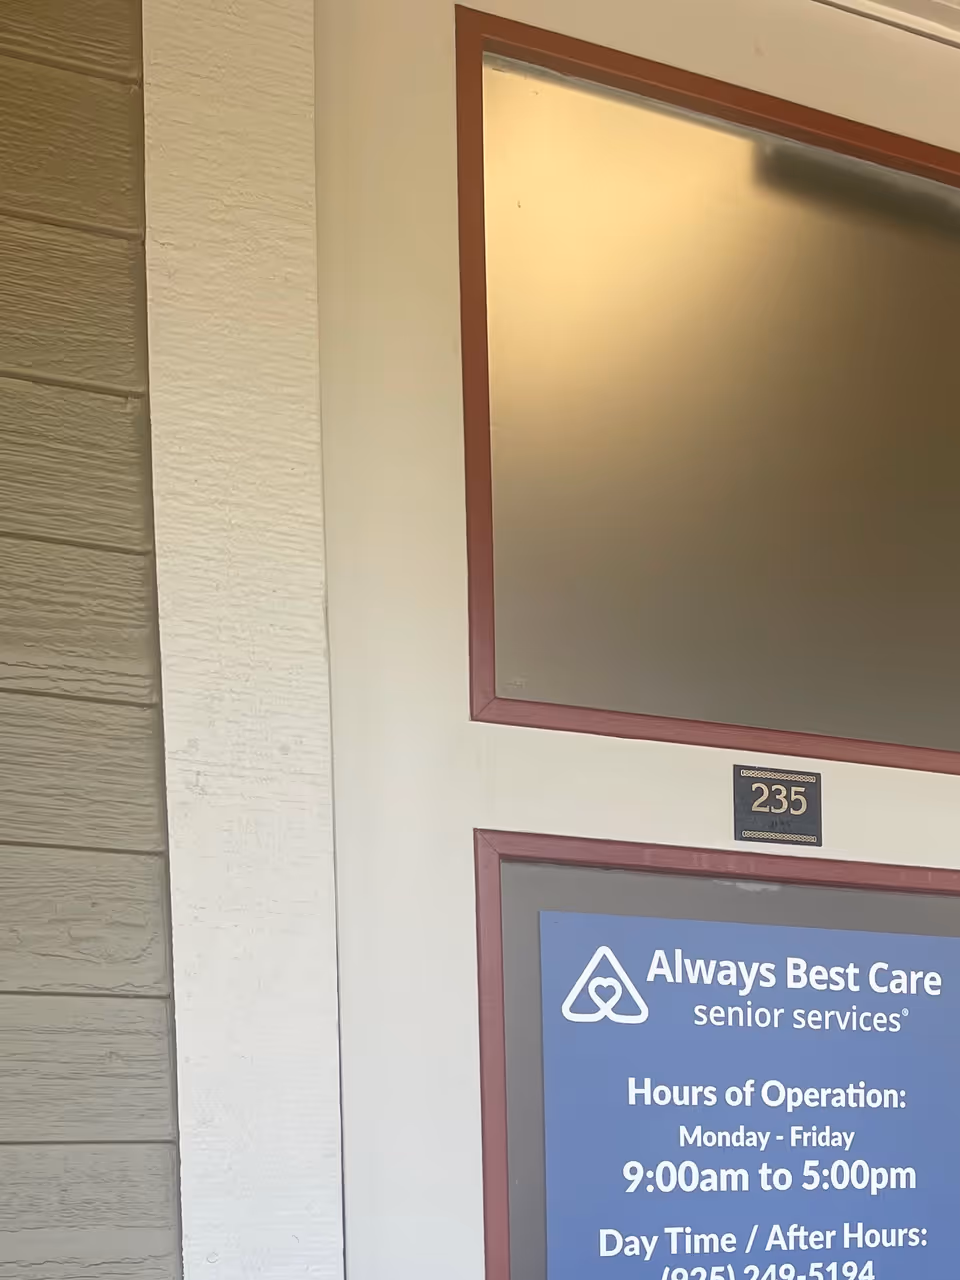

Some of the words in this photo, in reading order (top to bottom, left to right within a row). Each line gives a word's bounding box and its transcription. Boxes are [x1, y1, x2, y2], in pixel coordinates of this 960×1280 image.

[751, 783, 807, 815] 235
[646, 948, 777, 997] Always
[786, 956, 860, 992] Best
[868, 961, 942, 996] Care
[693, 1000, 785, 1028] senior
[628, 1077, 718, 1107] Hours
[724, 1079, 755, 1107] of
[761, 1079, 906, 1113] Operation:
[679, 1124, 771, 1151] Monday
[790, 1125, 856, 1151] Friday
[622, 1160, 749, 1193] 9:00am
[758, 1162, 793, 1191] to
[801, 1159, 916, 1196] 5:00pm
[599, 1228, 659, 1261] Day
[663, 1226, 737, 1255] Time
[744, 1224, 759, 1254] /
[764, 1223, 837, 1251] After
[843, 1222, 928, 1249] Hours:
